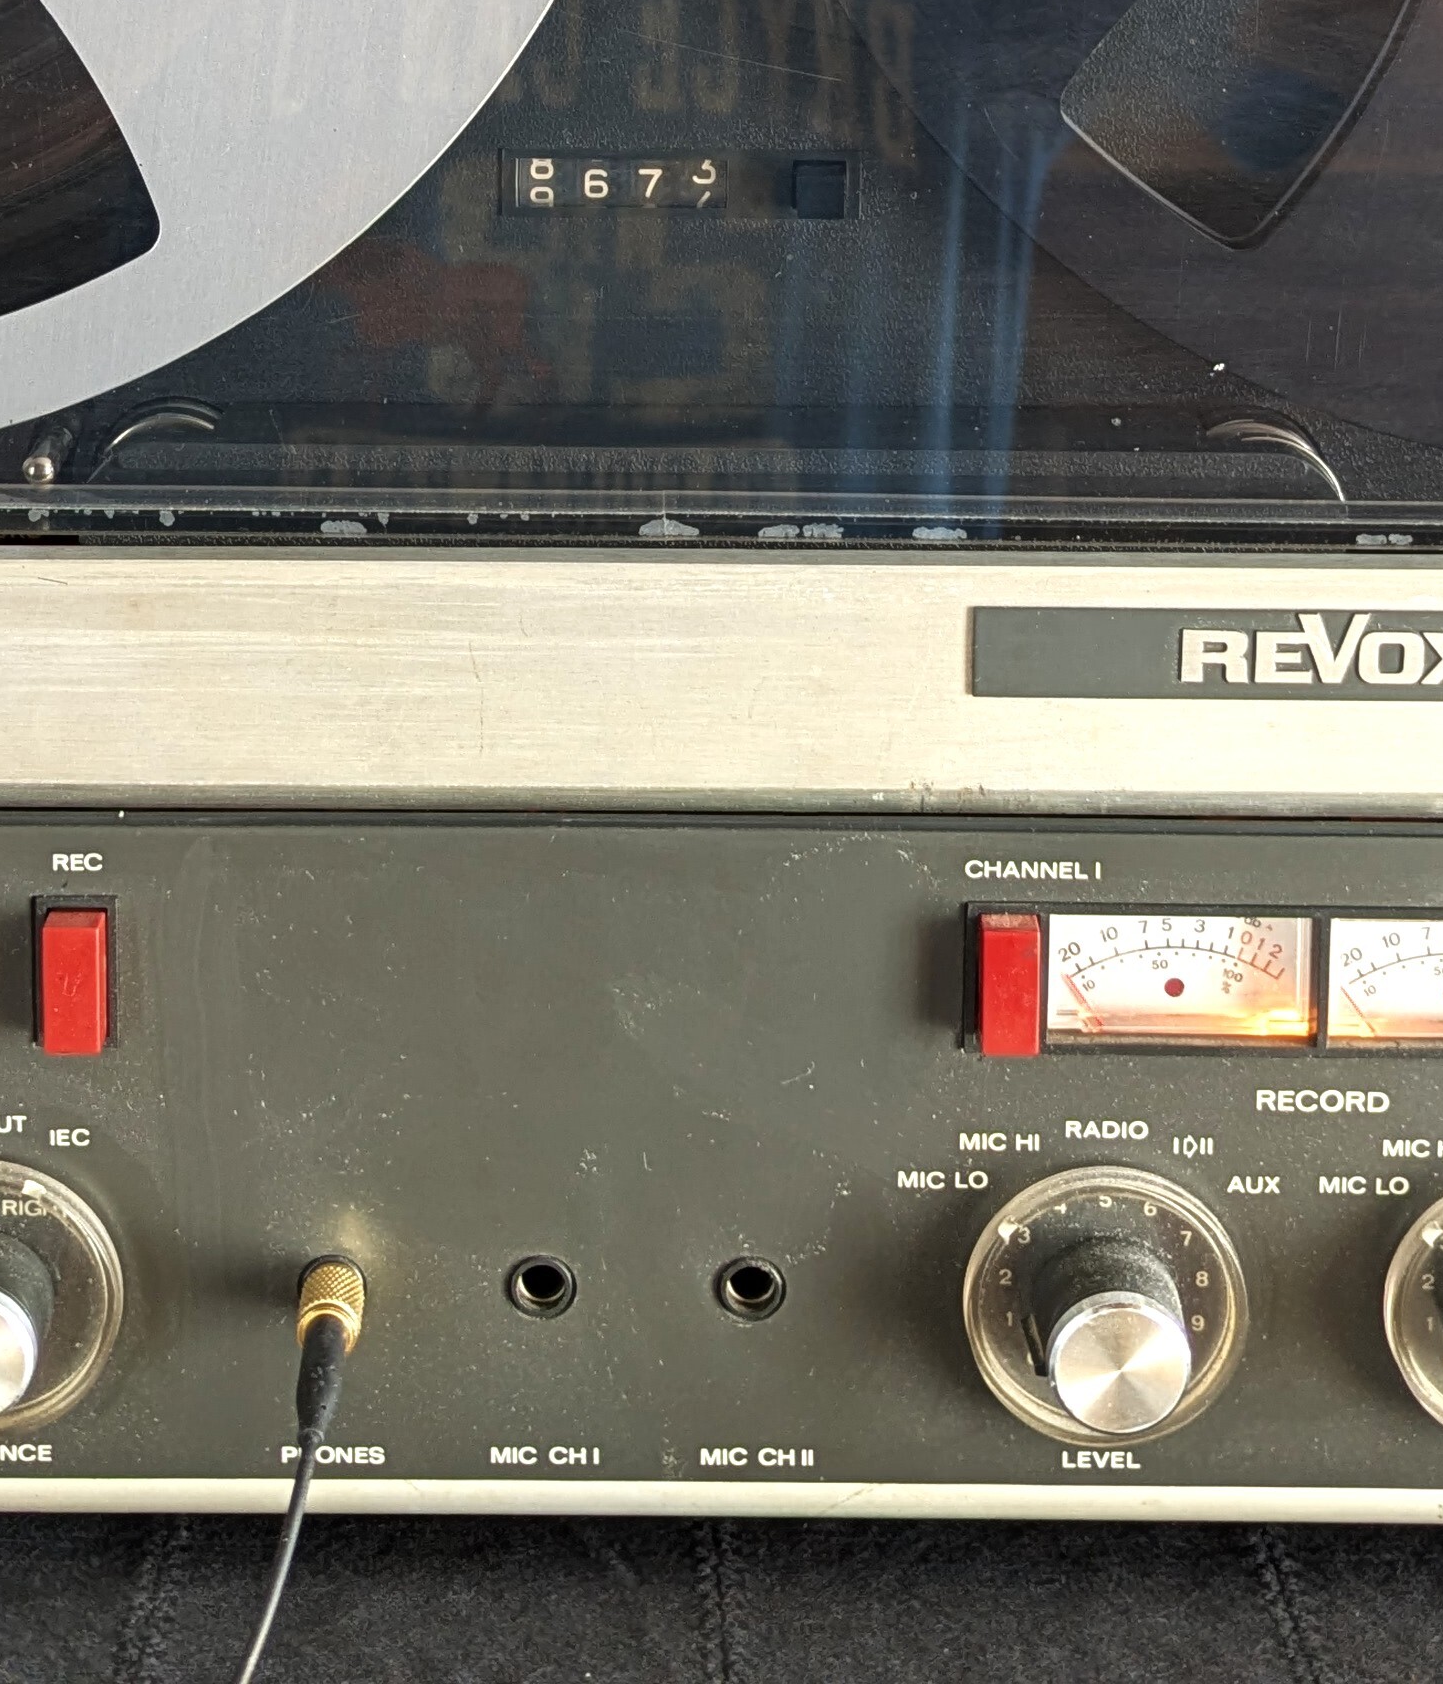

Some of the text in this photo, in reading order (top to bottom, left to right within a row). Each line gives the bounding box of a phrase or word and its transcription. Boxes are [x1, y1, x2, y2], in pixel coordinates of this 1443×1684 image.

[52, 852, 103, 872] REC
[964, 859, 1101, 880] CHANNEL I
[1255, 1089, 1391, 1113] RECORD
[49, 1128, 90, 1147] IEC
[1065, 1120, 1149, 1140] RADIO
[959, 1132, 1040, 1152] MIC HI
[1382, 1138, 1431, 1159] MIC
[897, 1170, 989, 1190] MIC LO
[1226, 1175, 1281, 1195] AUX
[1318, 1175, 1410, 1196] MIC LO
[0, 1198, 56, 1217] RIG
[1144, 1201, 1157, 1217] 6
[1017, 1227, 1031, 1244] 3
[1180, 1230, 1192, 1247] 7
[999, 1269, 1012, 1286] 2
[1195, 1271, 1209, 1287] 8
[1421, 1274, 1435, 1290] 2
[1191, 1315, 1205, 1331] 9
[280, 1444, 387, 1465] PONES
[490, 1446, 600, 1465] MIC CH I
[700, 1446, 814, 1467] MIC CH II
[1061, 1450, 1141, 1470] LEVEL
